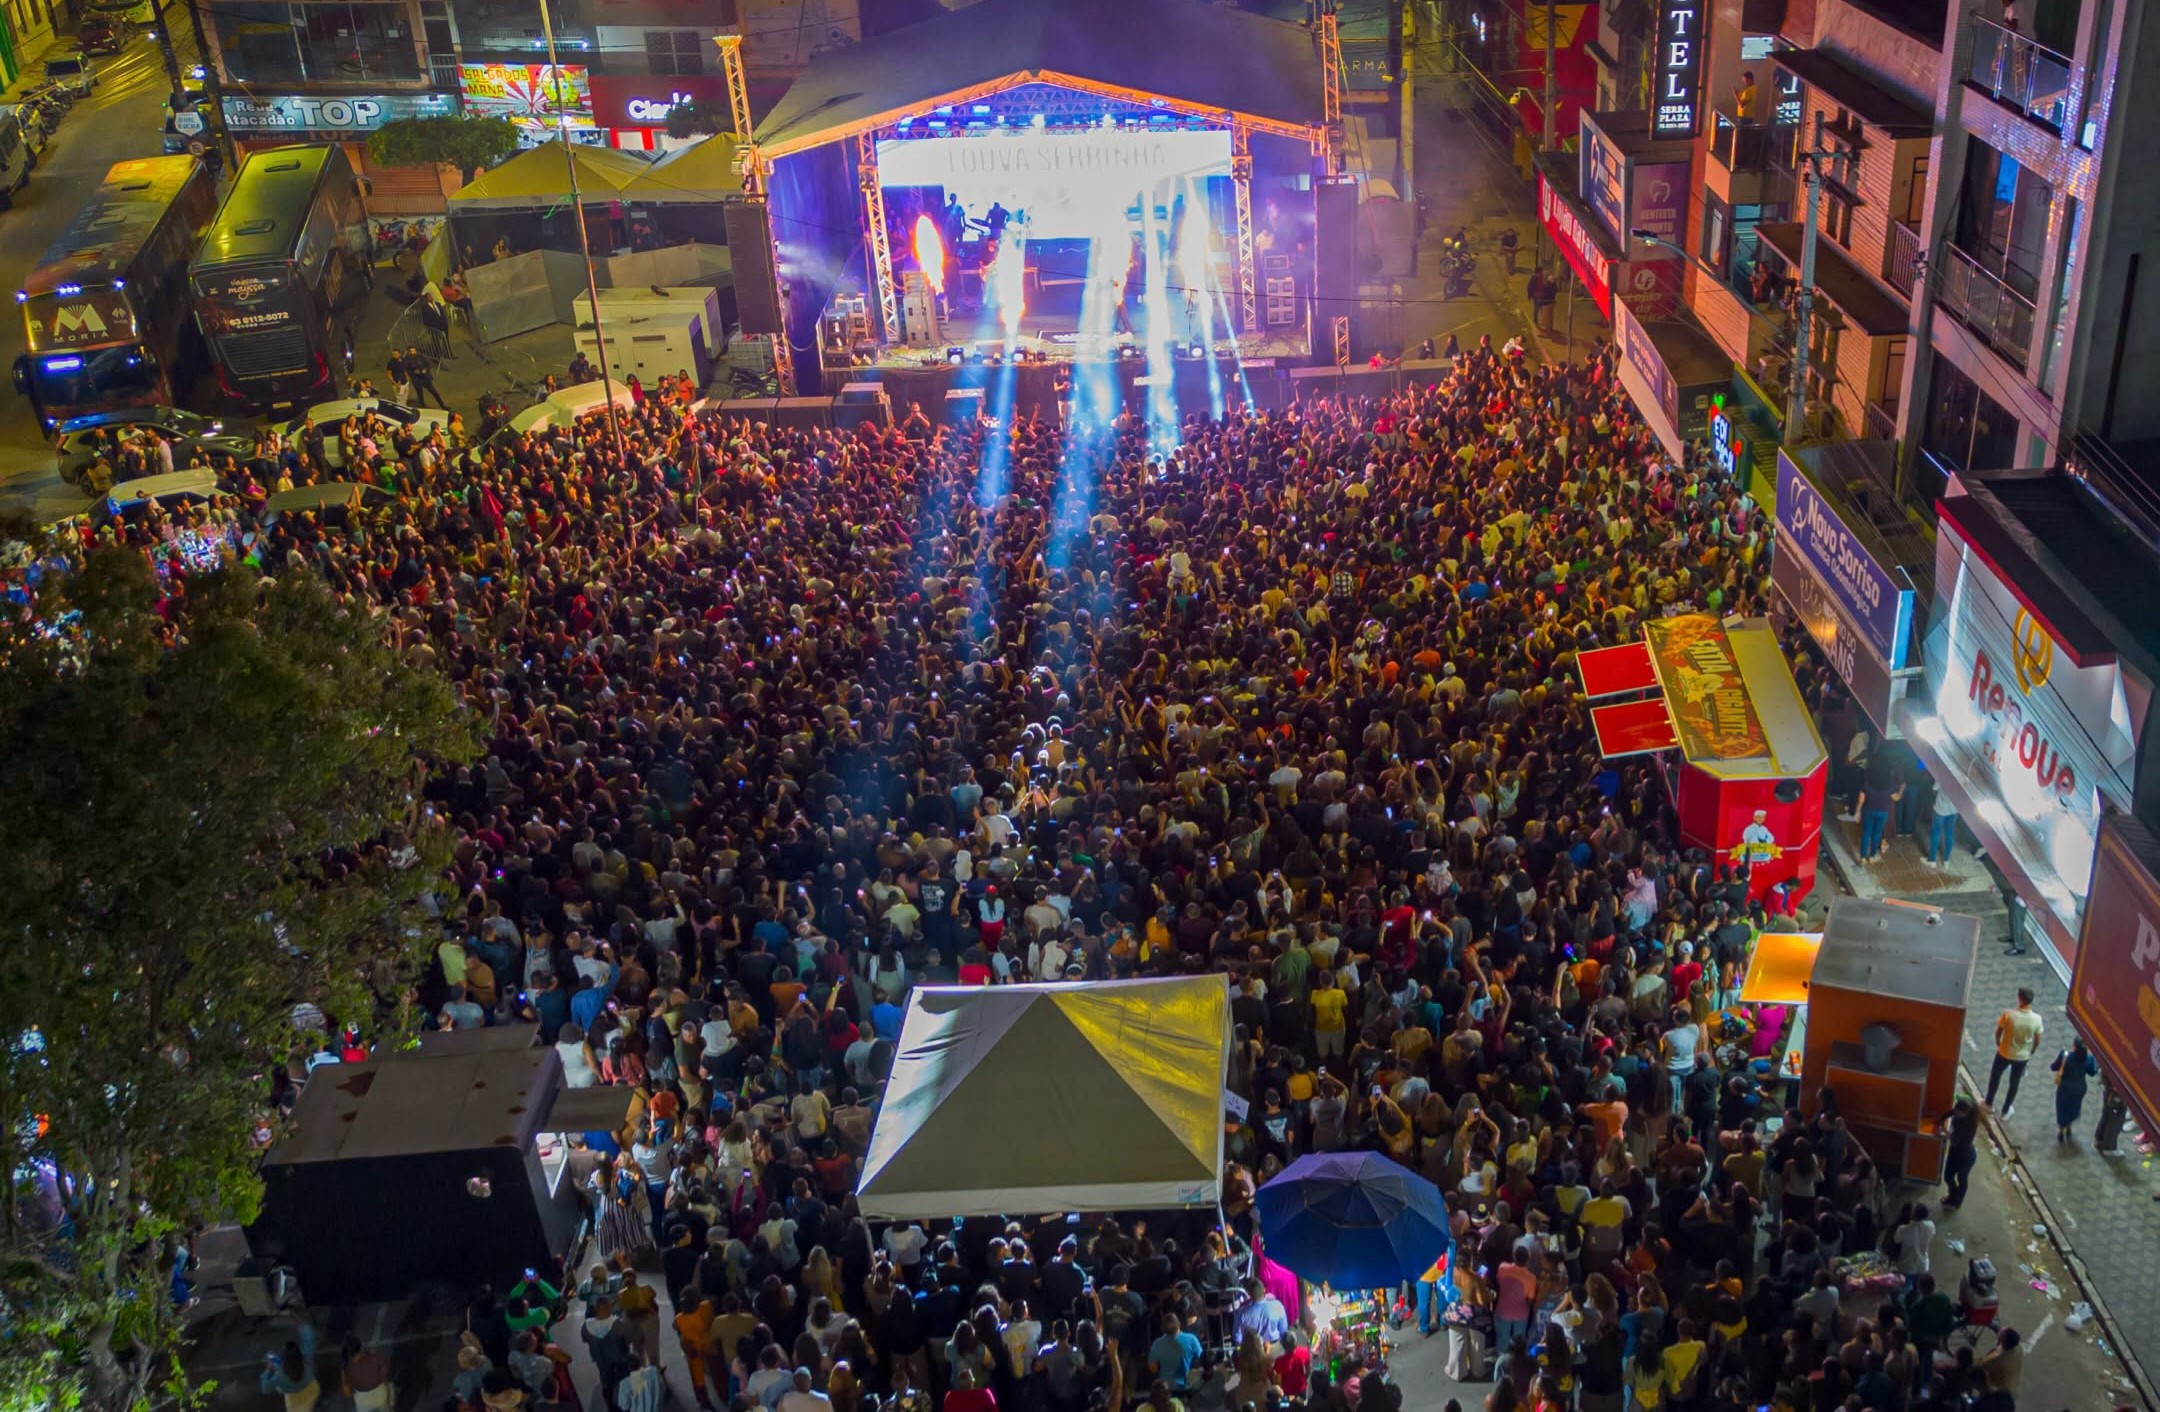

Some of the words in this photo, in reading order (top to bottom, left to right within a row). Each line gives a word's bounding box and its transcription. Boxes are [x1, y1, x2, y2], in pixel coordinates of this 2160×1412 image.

[1667, 0, 1693, 98] TEL
[1340, 60, 1387, 71] ARMA
[225, 113, 296, 126] Atacadão
[292, 100, 381, 126] TOP
[1659, 113, 1690, 122] PLAZA
[1660, 104, 1691, 114] SERRA
[1037, 143, 1168, 171] SERRINHA
[1807, 493, 1838, 555] Novo
[1838, 532, 1881, 609] Sorriso
[1687, 638, 1733, 674] FATIA
[1713, 687, 1750, 737] GIGANTE
